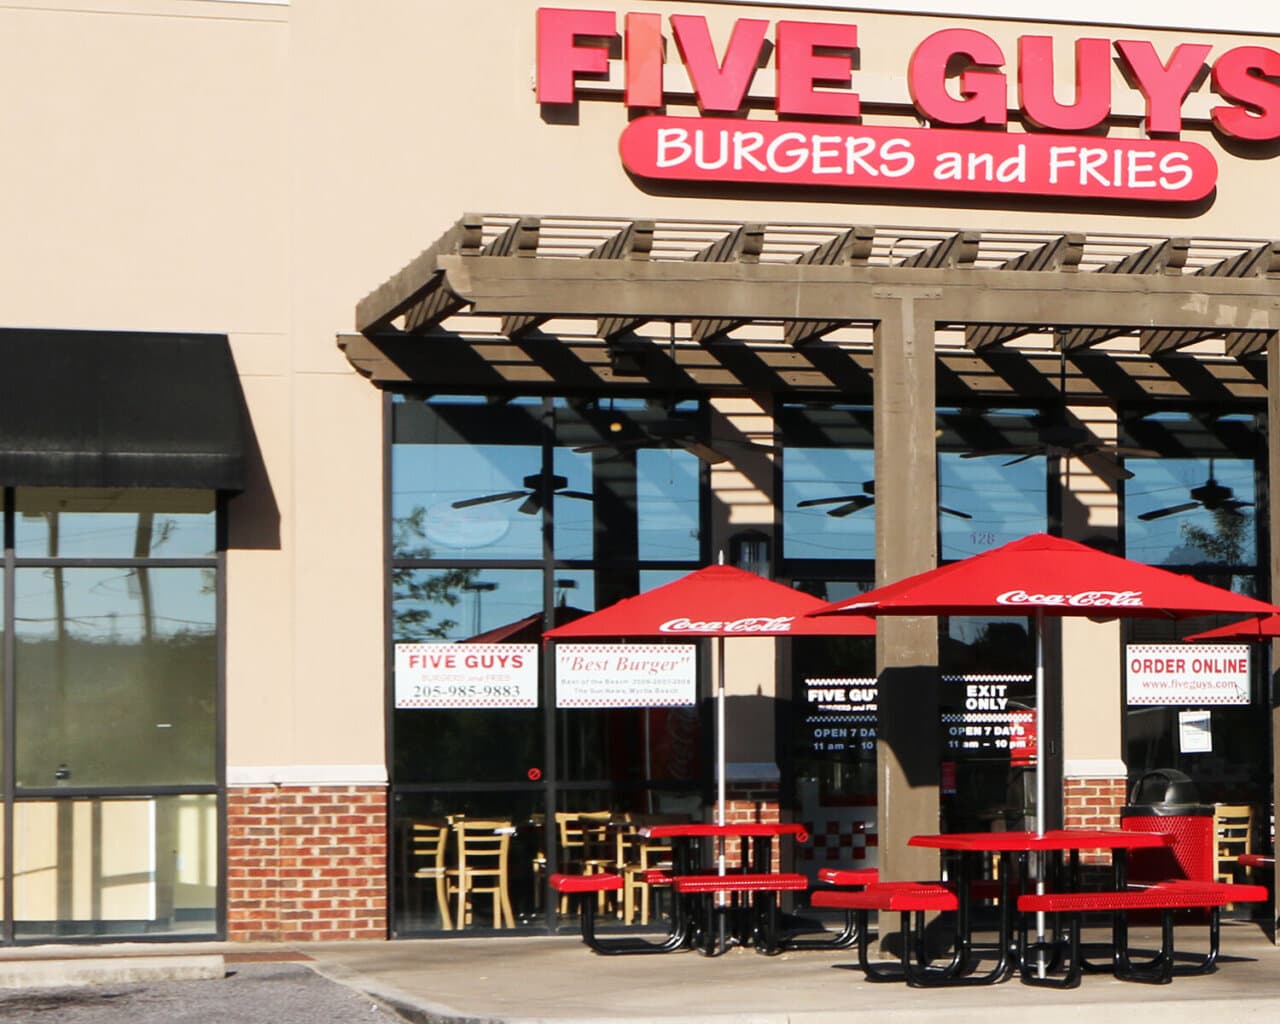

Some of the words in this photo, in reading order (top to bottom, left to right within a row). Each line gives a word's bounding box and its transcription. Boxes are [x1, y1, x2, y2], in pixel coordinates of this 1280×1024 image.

[535, 7, 861, 117] FIVE
[655, 127, 915, 180] BURGERS
[933, 143, 1026, 184] and
[1049, 145, 1194, 191] FRIES
[996, 590, 1144, 607] Coca-Cola
[659, 616, 797, 632] Coca-Cola
[409, 654, 456, 669] FIVE
[465, 654, 524, 669] GUYS
[1131, 658, 1186, 674] ORDER
[1192, 658, 1248, 674] ONLINE
[414, 685, 521, 698] 205-985-9883
[966, 685, 1007, 697] EXIT
[1142, 679, 1237, 691] www.fiveguys.com
[808, 688, 846, 703] FIVE
[849, 688, 878, 703] GU
[965, 698, 1009, 711] ONLY
[814, 728, 848, 738] OPEN
[849, 728, 857, 738] 7
[860, 728, 877, 738] DA
[949, 726, 982, 736] OPEN
[983, 726, 992, 736] 7
[994, 726, 1025, 736] DAYS
[814, 741, 824, 750] 11
[828, 742, 845, 751] am
[861, 741, 874, 750] 10
[949, 740, 960, 749] 11
[995, 739, 1008, 749] 10
